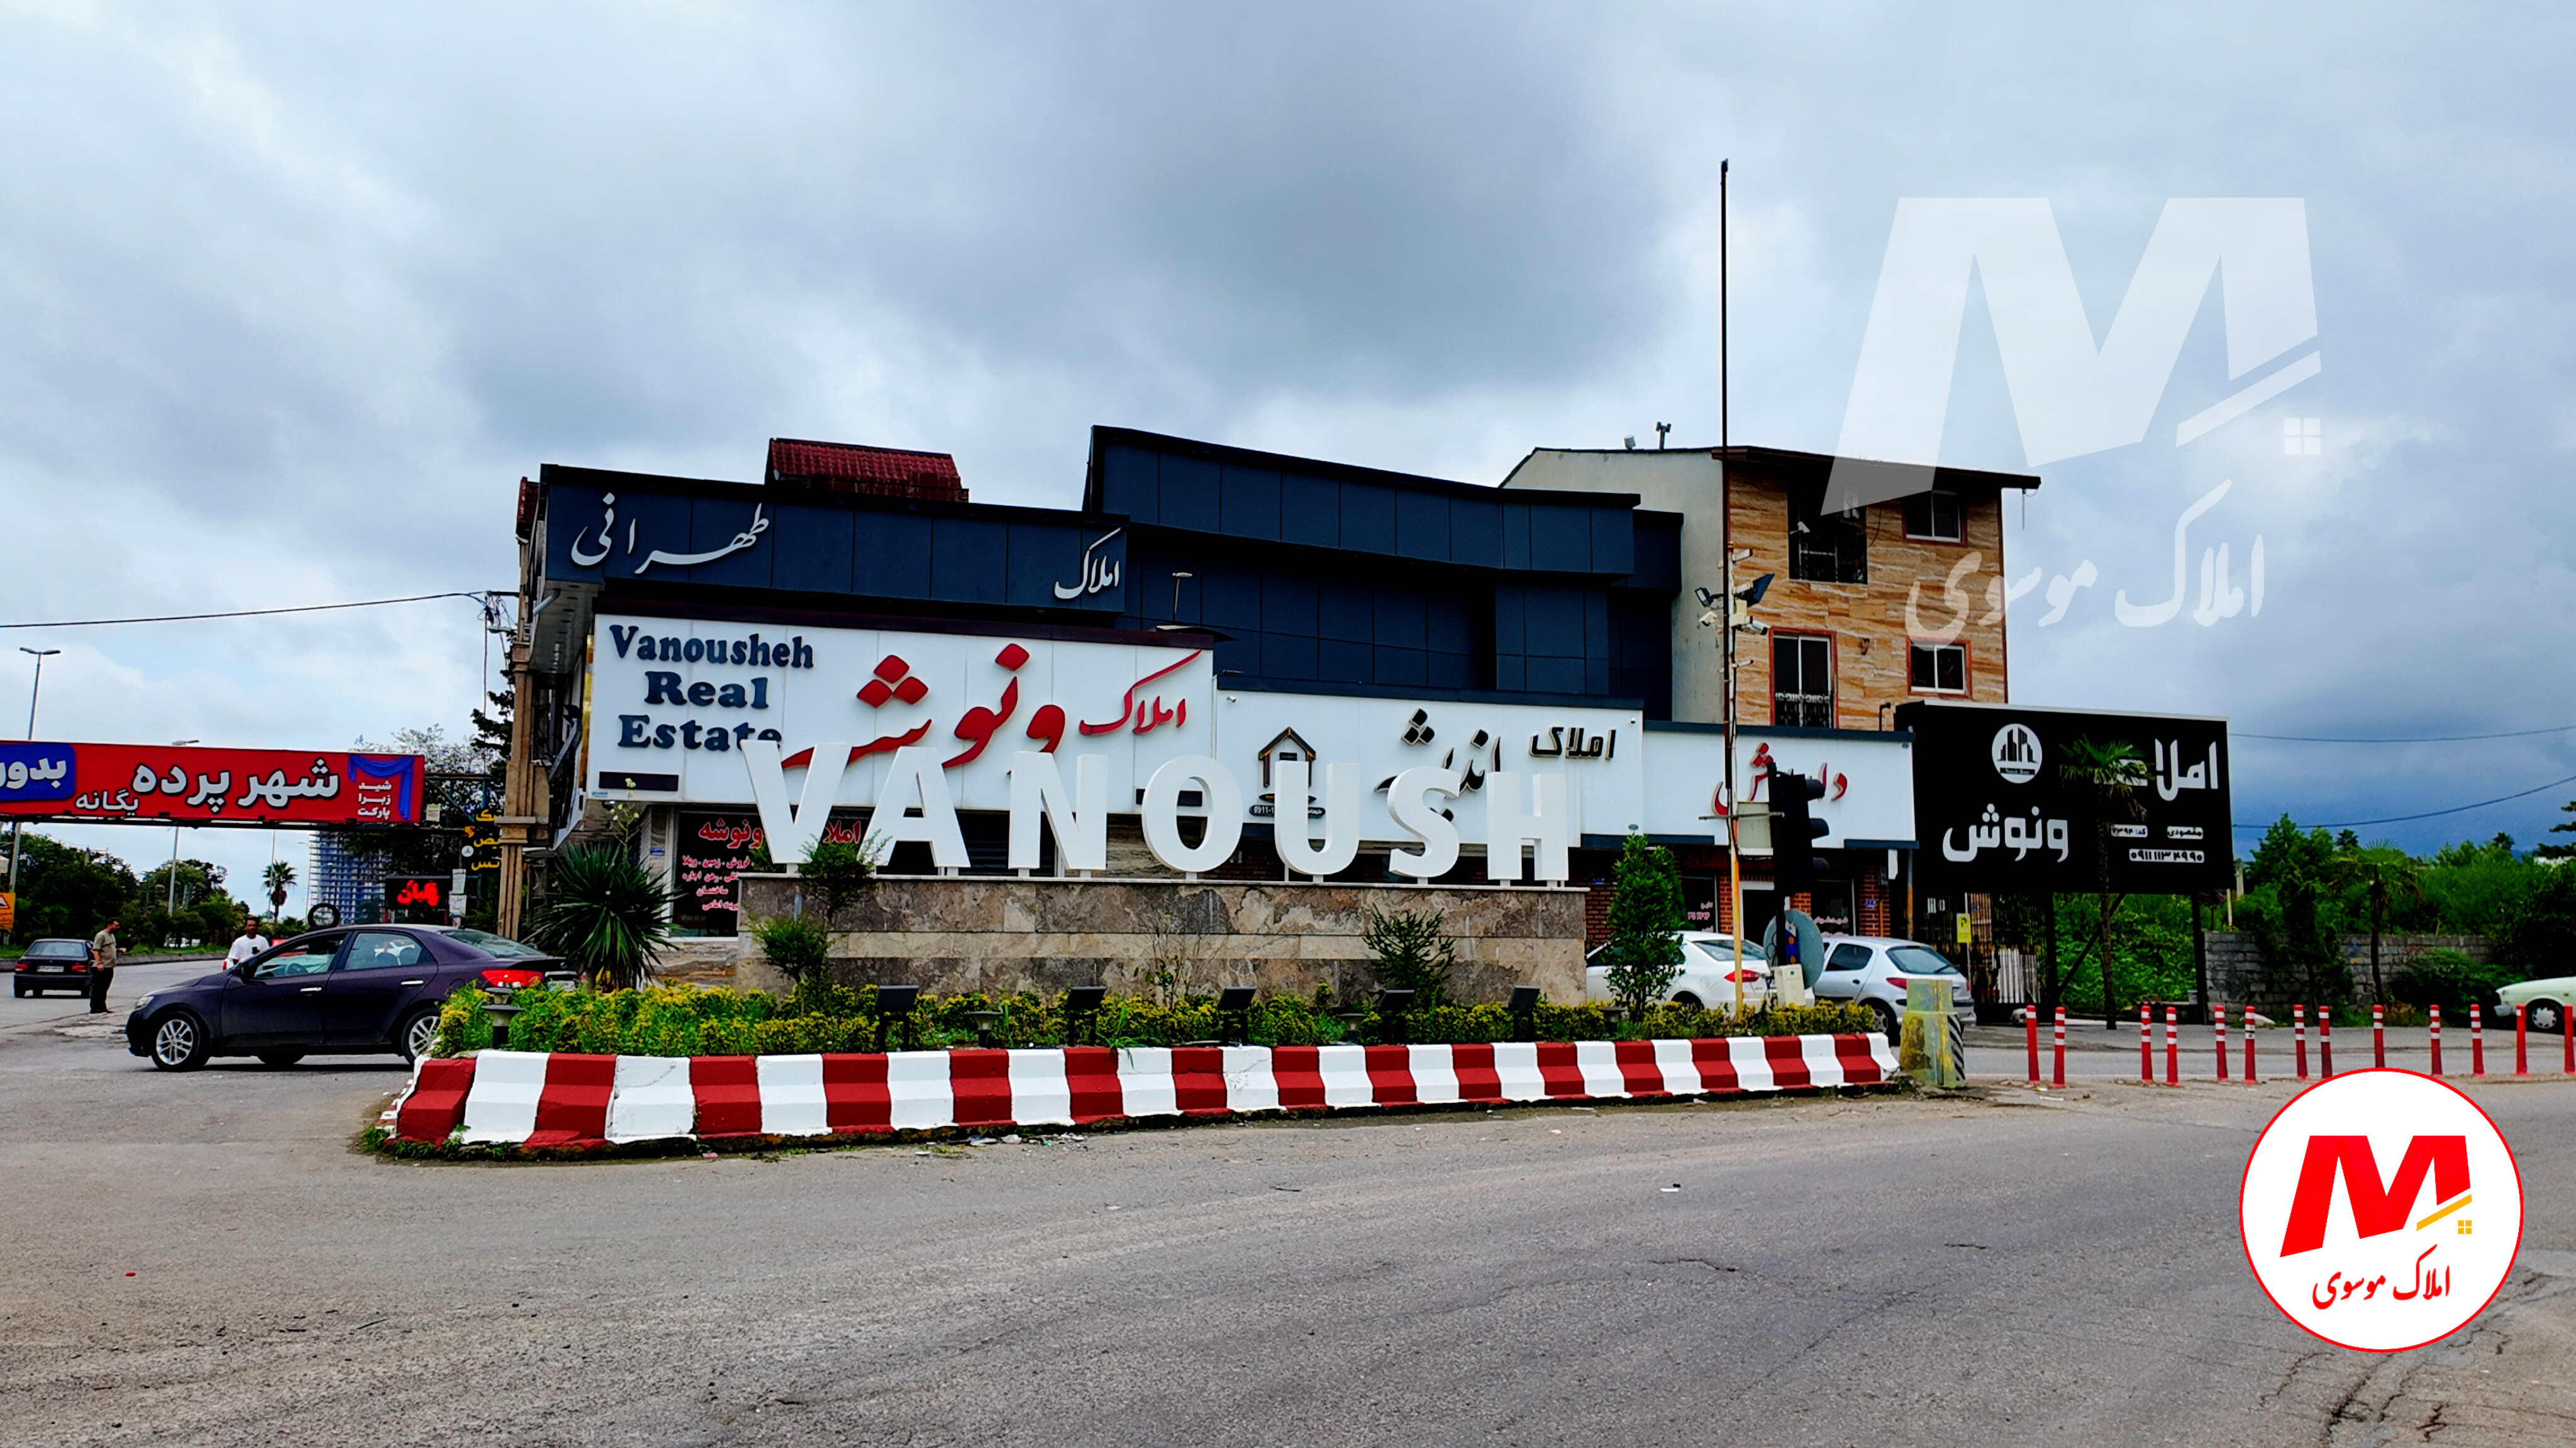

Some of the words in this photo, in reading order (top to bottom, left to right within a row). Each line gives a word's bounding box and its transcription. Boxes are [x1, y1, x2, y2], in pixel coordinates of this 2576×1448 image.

[570, 492, 770, 574] طهرانی
[1054, 527, 1121, 599] املاک
[609, 625, 814, 669] Vanousheh
[644, 671, 769, 710] Real
[1079, 649, 1202, 735] املاک
[617, 714, 783, 751] Estate
[1528, 726, 1616, 760] املاک
[75, 789, 139, 816] یگانه
[132, 763, 230, 813] پرده
[238, 757, 338, 807] شهر
[358, 793, 391, 805] زبرا
[357, 807, 391, 820] پارکت
[741, 740, 1569, 881] VANOUSH
[698, 818, 763, 849] ونوشه
[823, 820, 861, 844] املا
[1943, 803, 2068, 862] ونوش
